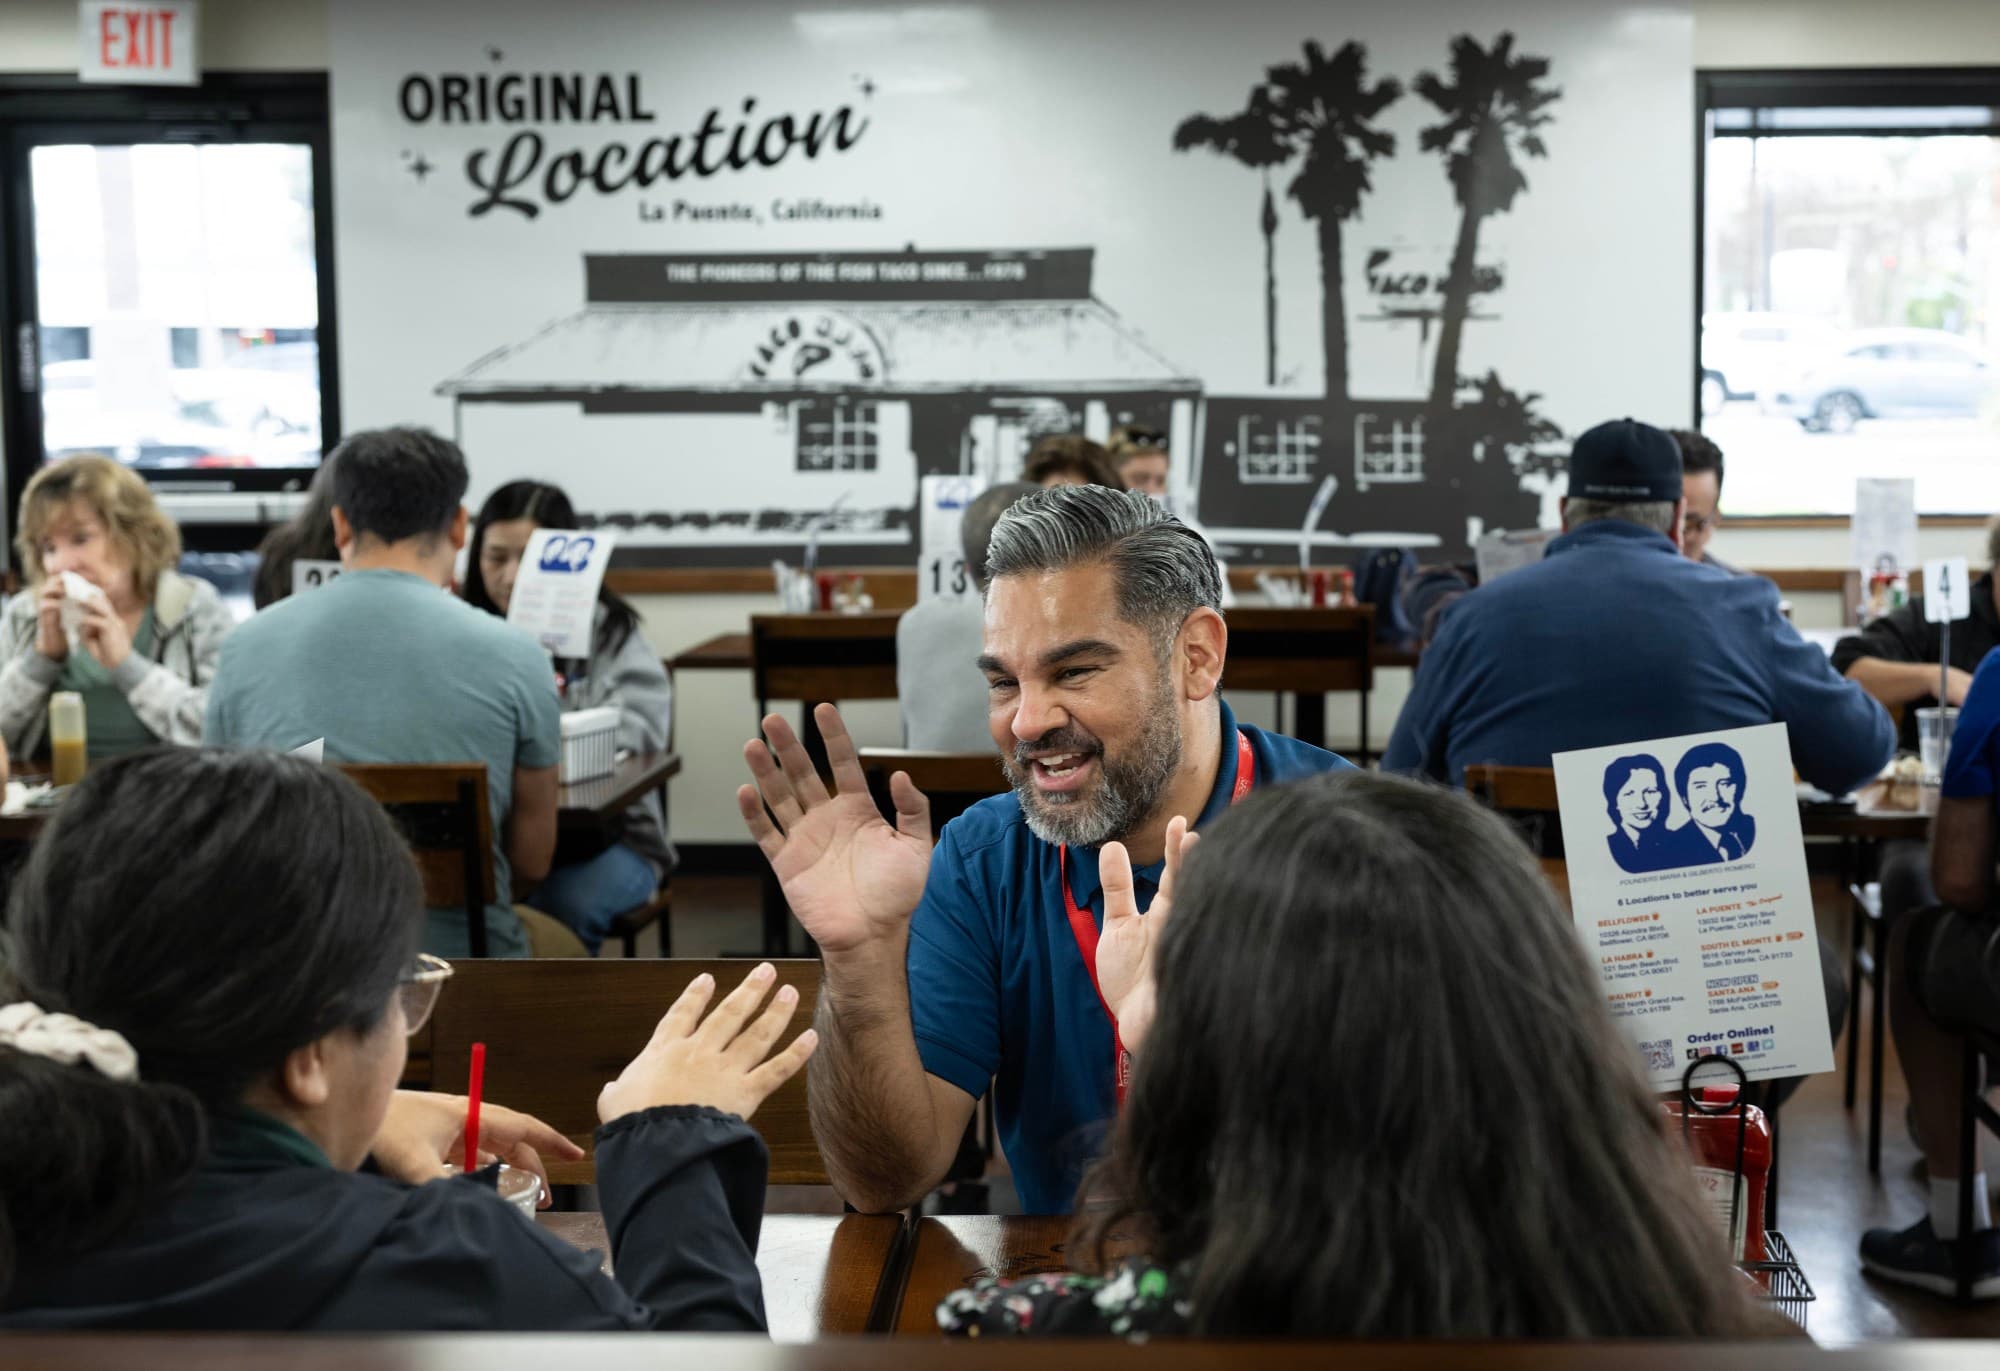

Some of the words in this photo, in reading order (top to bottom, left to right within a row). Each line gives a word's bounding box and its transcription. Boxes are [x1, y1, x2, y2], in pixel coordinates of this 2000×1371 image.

[100, 9, 177, 67] EXIT
[400, 73, 654, 124] ORIGINAL
[466, 98, 869, 221] Location
[638, 200, 665, 222] La
[772, 198, 882, 222] California
[666, 262, 698, 283] THE
[700, 262, 777, 283] PIONEERS
[804, 262, 835, 283] THE
[878, 261, 920, 282] TACO
[931, 560, 967, 594] 13
[1939, 564, 1952, 599] 4
[1625, 893, 1670, 905] Locations
[1672, 892, 1682, 900] to
[1684, 888, 1710, 898] better
[1713, 886, 1738, 894] serve
[1740, 883, 1757, 893] you
[1709, 903, 1742, 913] PUENTE
[1598, 914, 1650, 927] BELLFLOWER
[1721, 915, 1736, 923] East
[1738, 914, 1758, 922] Valley
[1698, 926, 1708, 934] La
[1737, 921, 1749, 929] CA
[1701, 942, 1730, 951] SOUTH
[1731, 940, 1741, 948] EL
[1742, 936, 1772, 946] MONTE
[1602, 956, 1614, 964] LA
[1614, 953, 1644, 963] HABRA
[1618, 962, 1638, 971] South
[1640, 960, 1661, 968] Beach
[1703, 960, 1723, 968] South
[1725, 958, 1733, 966] El
[1759, 954, 1770, 962] CA
[1604, 973, 1614, 981] La
[1639, 968, 1650, 976] CA
[1706, 977, 1731, 989] NOW
[1731, 974, 1759, 986] OPEN
[1708, 988, 1736, 998] SANTA
[1738, 986, 1756, 994] ANA
[1627, 999, 1647, 1007] North
[1648, 997, 1671, 1005] Grand
[1709, 1006, 1730, 1015] Santa
[1748, 1001, 1759, 1009] CA
[1637, 1007, 1648, 1015] CA
[1687, 1031, 1724, 1044] Order
[1727, 1024, 1775, 1039] Online!
